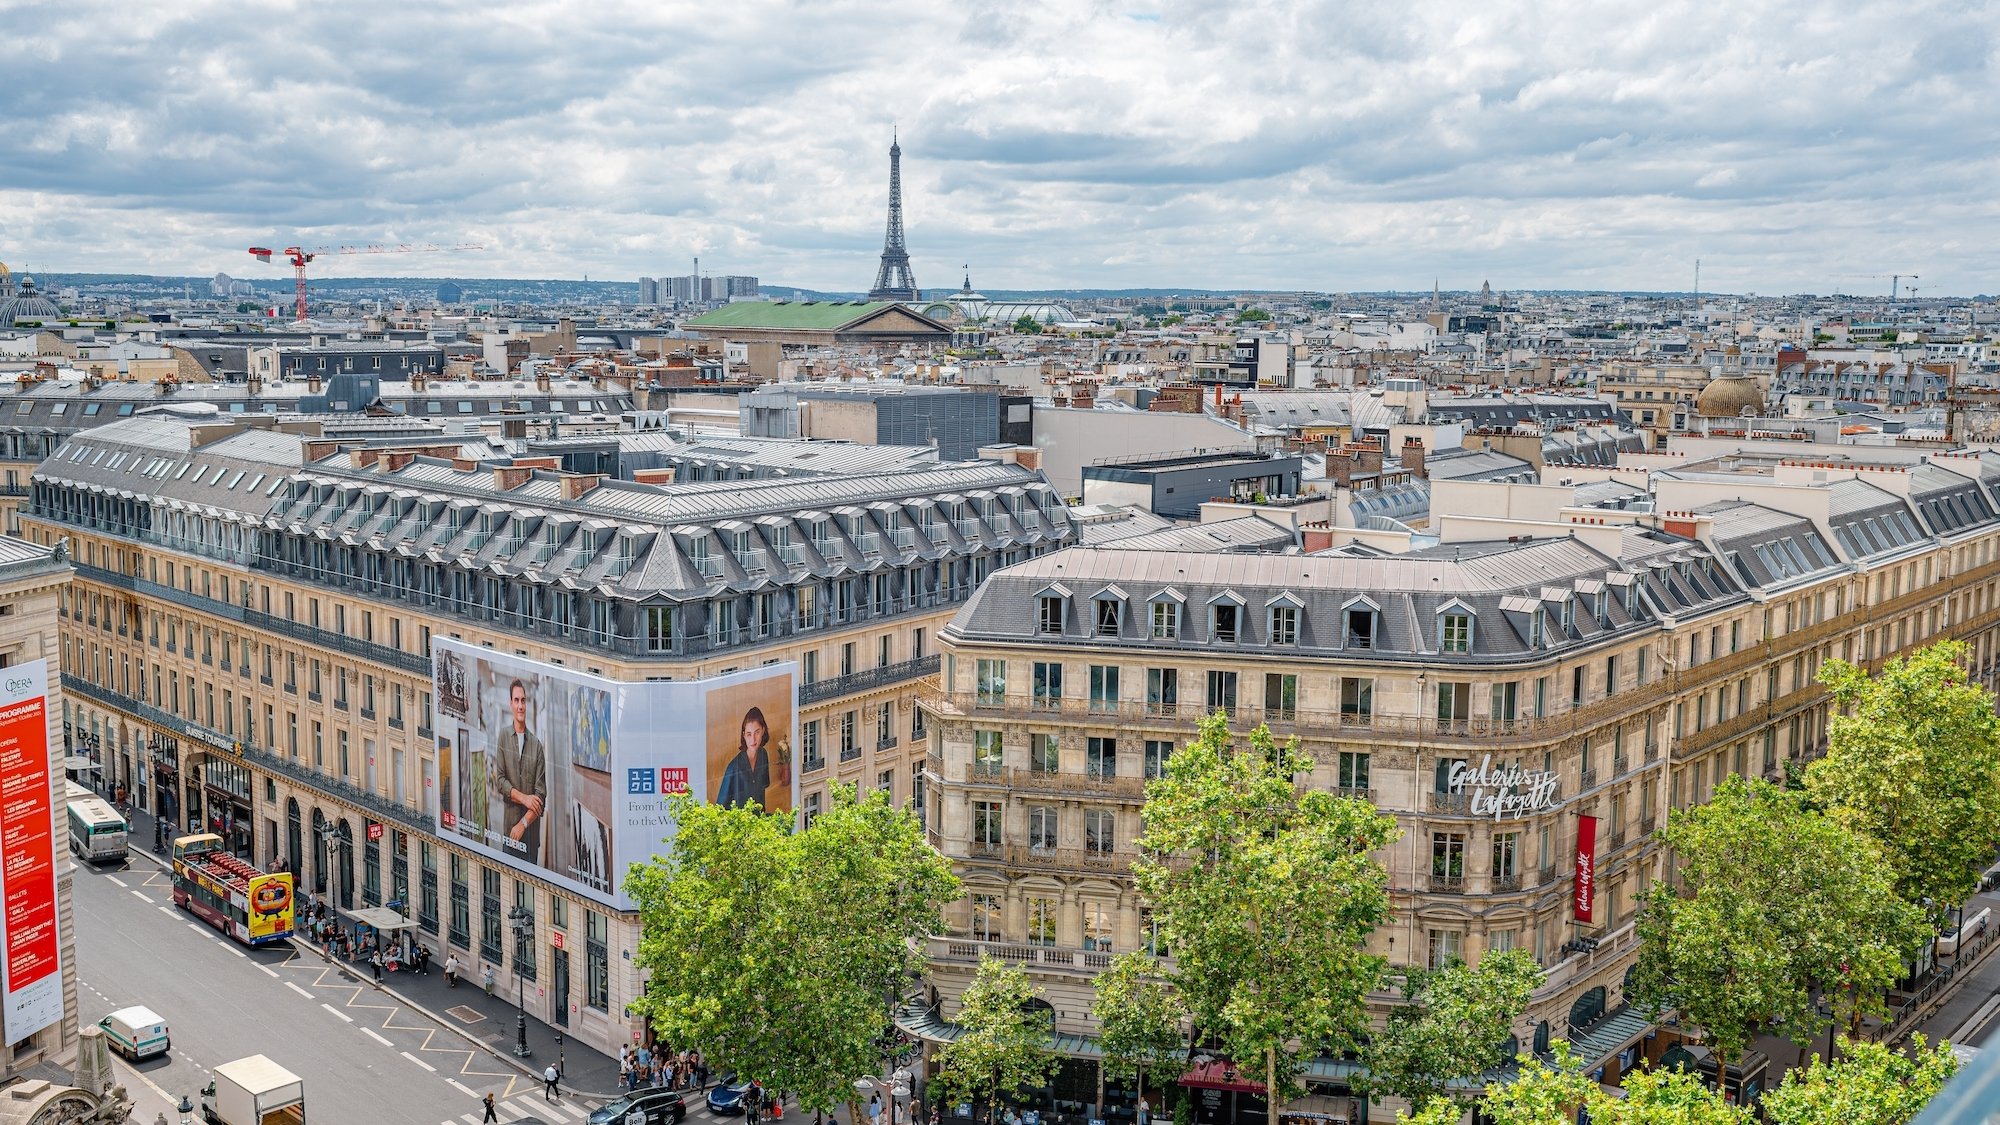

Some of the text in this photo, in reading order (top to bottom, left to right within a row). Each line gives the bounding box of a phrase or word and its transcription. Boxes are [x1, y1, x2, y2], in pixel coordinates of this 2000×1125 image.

[0, 703, 41, 720] PROGRAMME
[185, 725, 233, 753] SUISSE TOURISME
[663, 770, 684, 780] UNI
[1448, 754, 1532, 795] Galeries
[664, 781, 687, 792] QLO
[1471, 771, 1560, 822] Lafayette
[628, 802, 654, 811] From
[641, 816, 657, 825] the
[485, 828, 527, 853] ROGER FEDERER
[12, 907, 24, 916] GALA
[629, 1117, 642, 1125] Bolt
